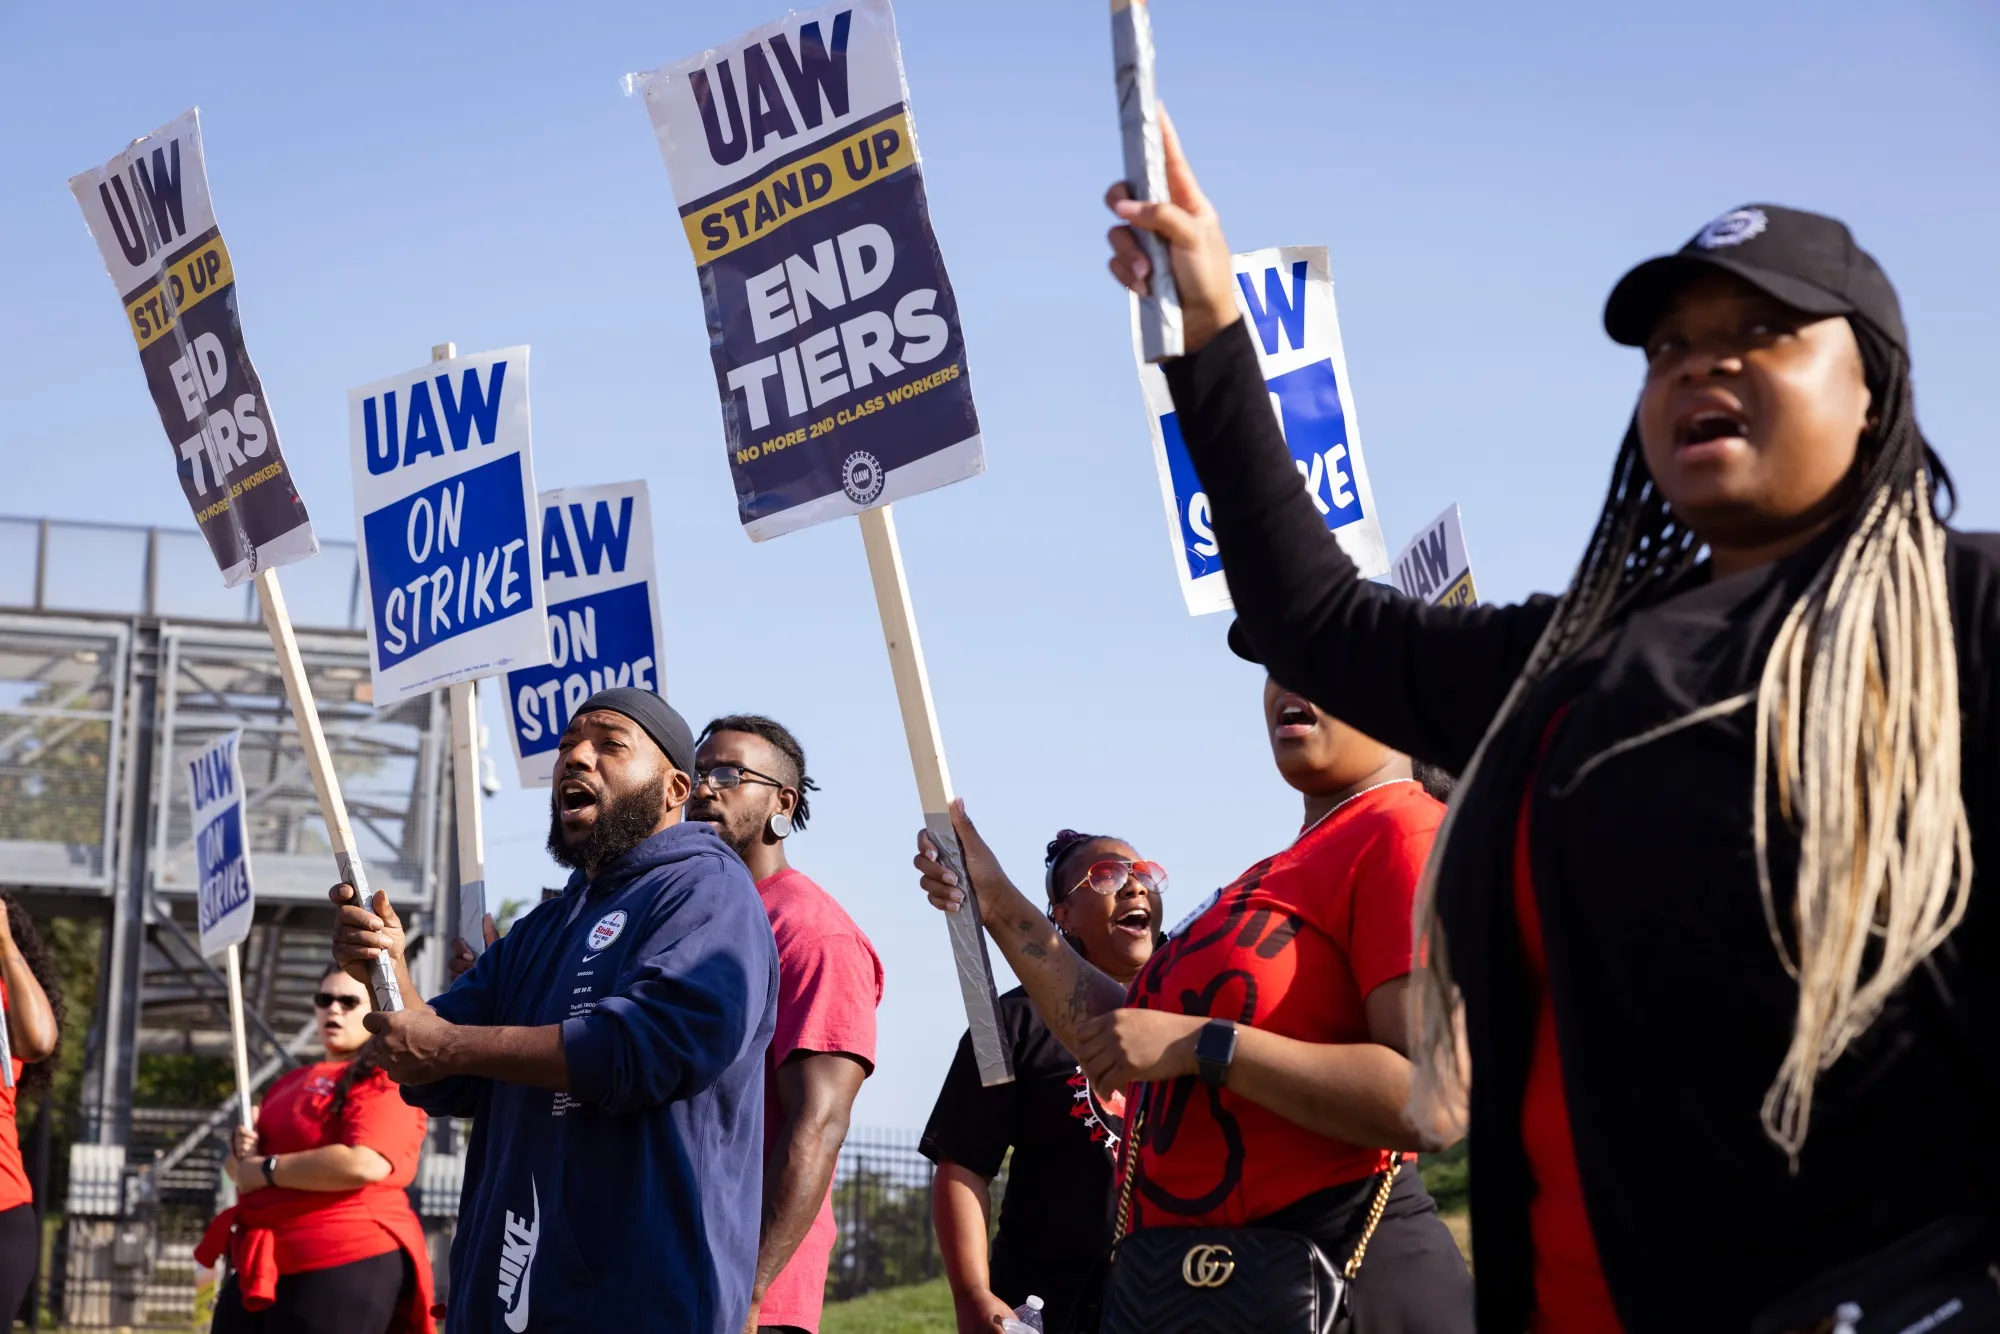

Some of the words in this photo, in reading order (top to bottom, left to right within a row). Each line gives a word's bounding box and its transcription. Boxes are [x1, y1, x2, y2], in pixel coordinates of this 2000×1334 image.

[688, 9, 853, 166] UAW
[99, 138, 187, 267] UAW
[700, 156, 832, 252] STAND
[842, 128, 900, 182] UP
[134, 274, 184, 339] STAD
[187, 249, 220, 294] UP
[745, 223, 894, 344] END
[727, 288, 949, 431] TIERS
[180, 393, 267, 496] TIRS
[363, 361, 508, 476] UAW
[736, 444, 760, 464] NO
[762, 428, 807, 456] MORE
[810, 416, 835, 440] 2ND
[836, 395, 885, 426] CLASS
[886, 363, 960, 406] WORKERS
[197, 509, 208, 525] NO
[207, 497, 229, 518] MORE
[229, 482, 243, 499] ASS
[241, 461, 282, 492] WORKERS
[407, 481, 465, 564] ON
[853, 469, 870, 483] UAW
[1188, 444, 1355, 557] SKE
[542, 497, 634, 580] AW
[384, 538, 525, 655] STRIKE
[548, 606, 598, 668] ON
[190, 740, 233, 811] UAW
[201, 858, 249, 927] STRIKE
[205, 818, 225, 870] ON
[595, 925, 615, 937] Strike
[498, 1209, 535, 1311] NIKE
